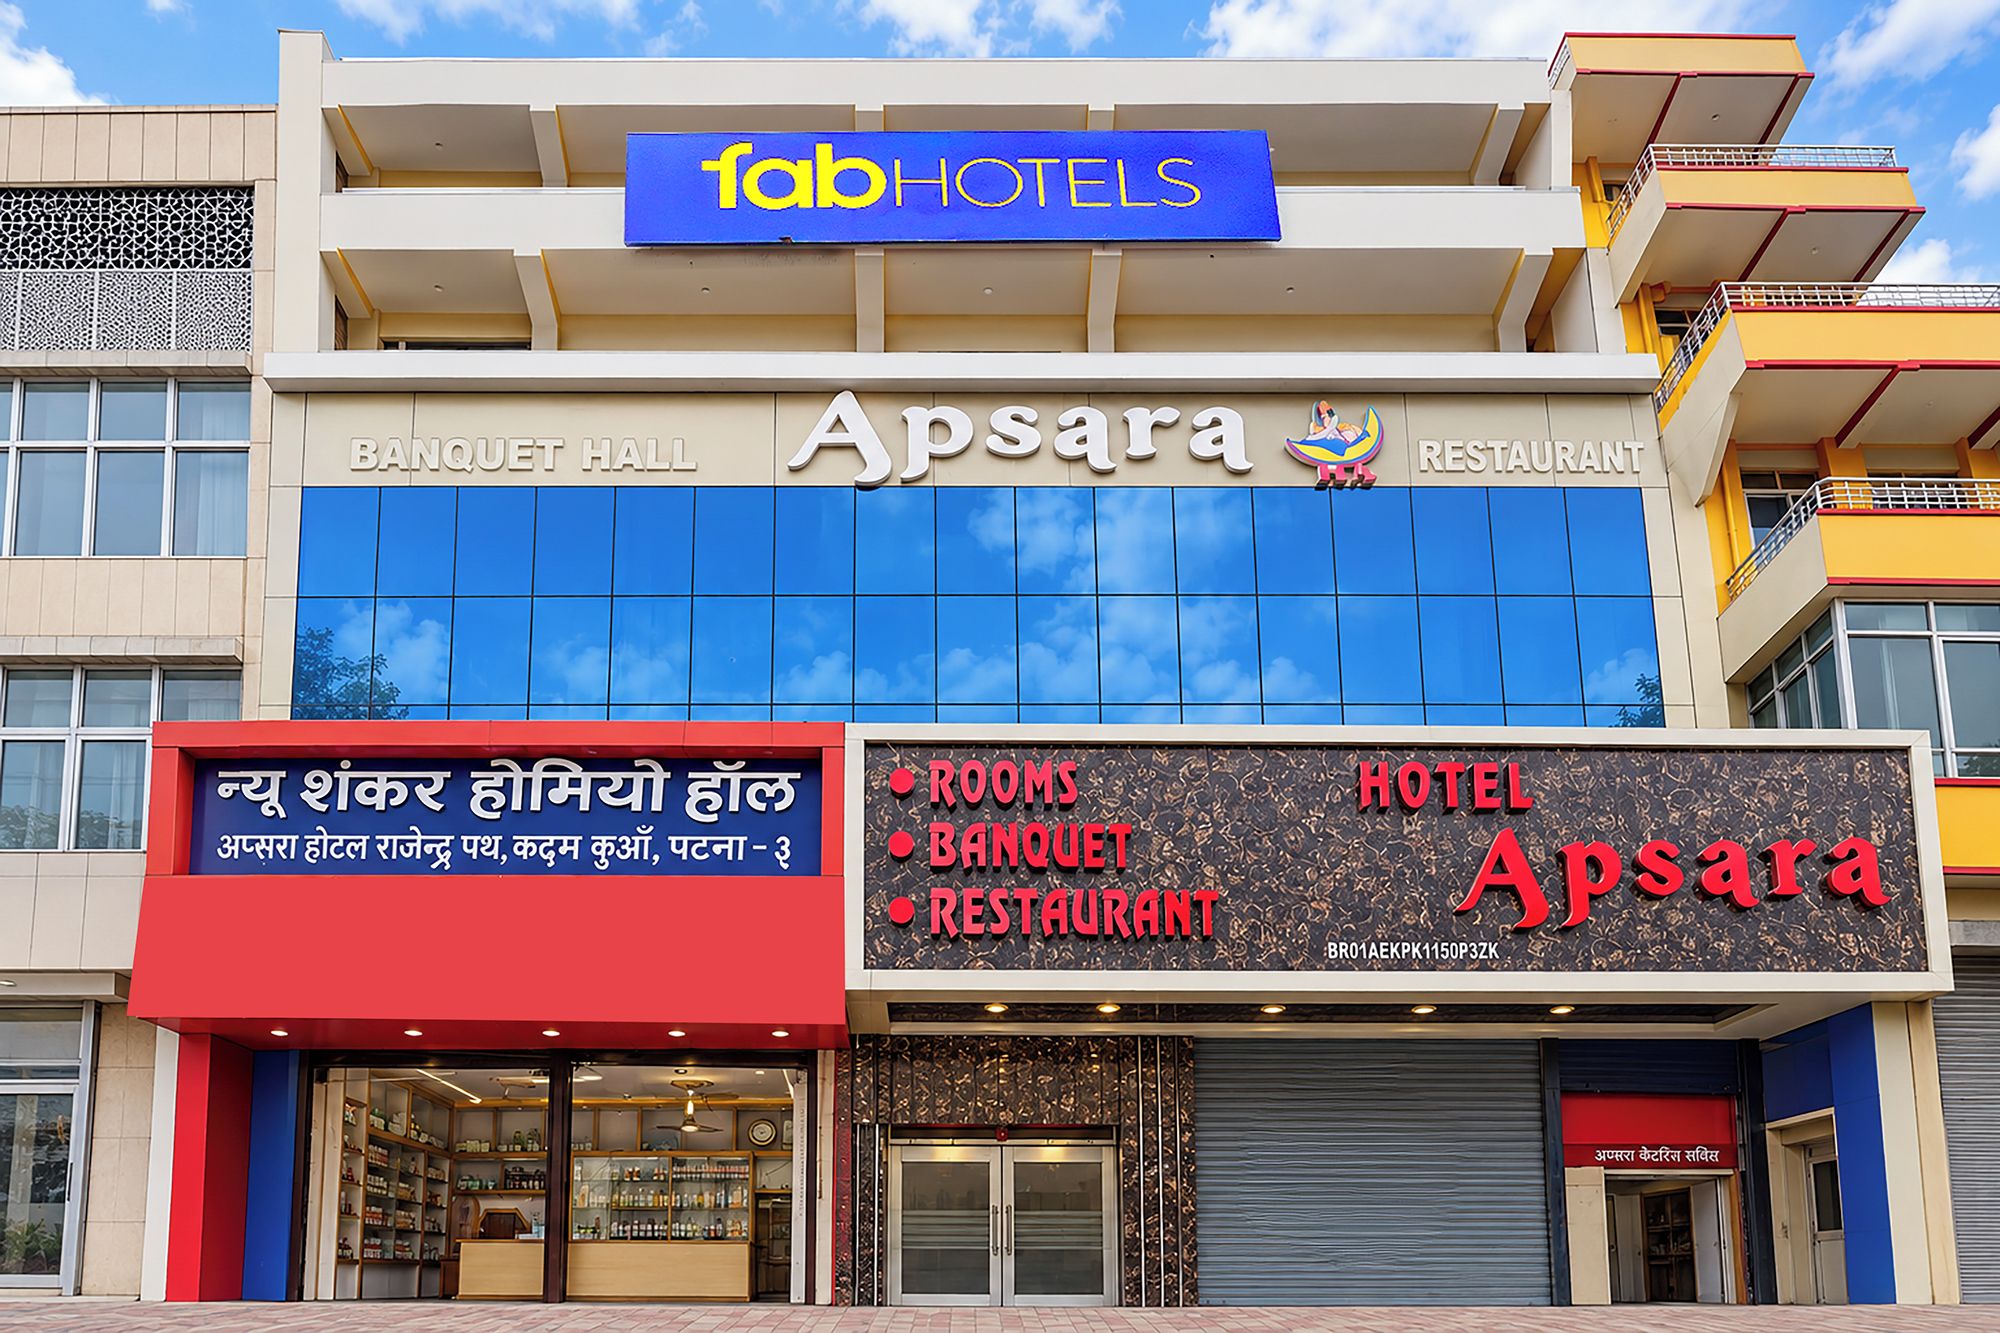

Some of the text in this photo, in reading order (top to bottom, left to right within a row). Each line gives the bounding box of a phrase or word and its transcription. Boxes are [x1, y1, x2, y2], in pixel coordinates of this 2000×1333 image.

[350, 437, 697, 474] BANQUET HALL
[788, 390, 1253, 487] Apsara
[1418, 439, 1644, 474] RESTAURANT
[217, 758, 801, 822] न्यू शंकर होमियो हॉल
[929, 760, 1078, 807] ROOMS
[1358, 761, 1533, 813] HOTEL
[217, 834, 299, 860] अप्सरा
[304, 826, 370, 863] होटल
[376, 826, 454, 870] राजेन्द्र
[513, 835, 582, 867] कदम
[668, 836, 748, 861] पटना
[928, 822, 1132, 870] BANQUET
[1452, 828, 1892, 931] Apsara
[928, 888, 1219, 939] RESTAURANT
[1327, 942, 1499, 959] BR01AEKPK1150P3ZK
